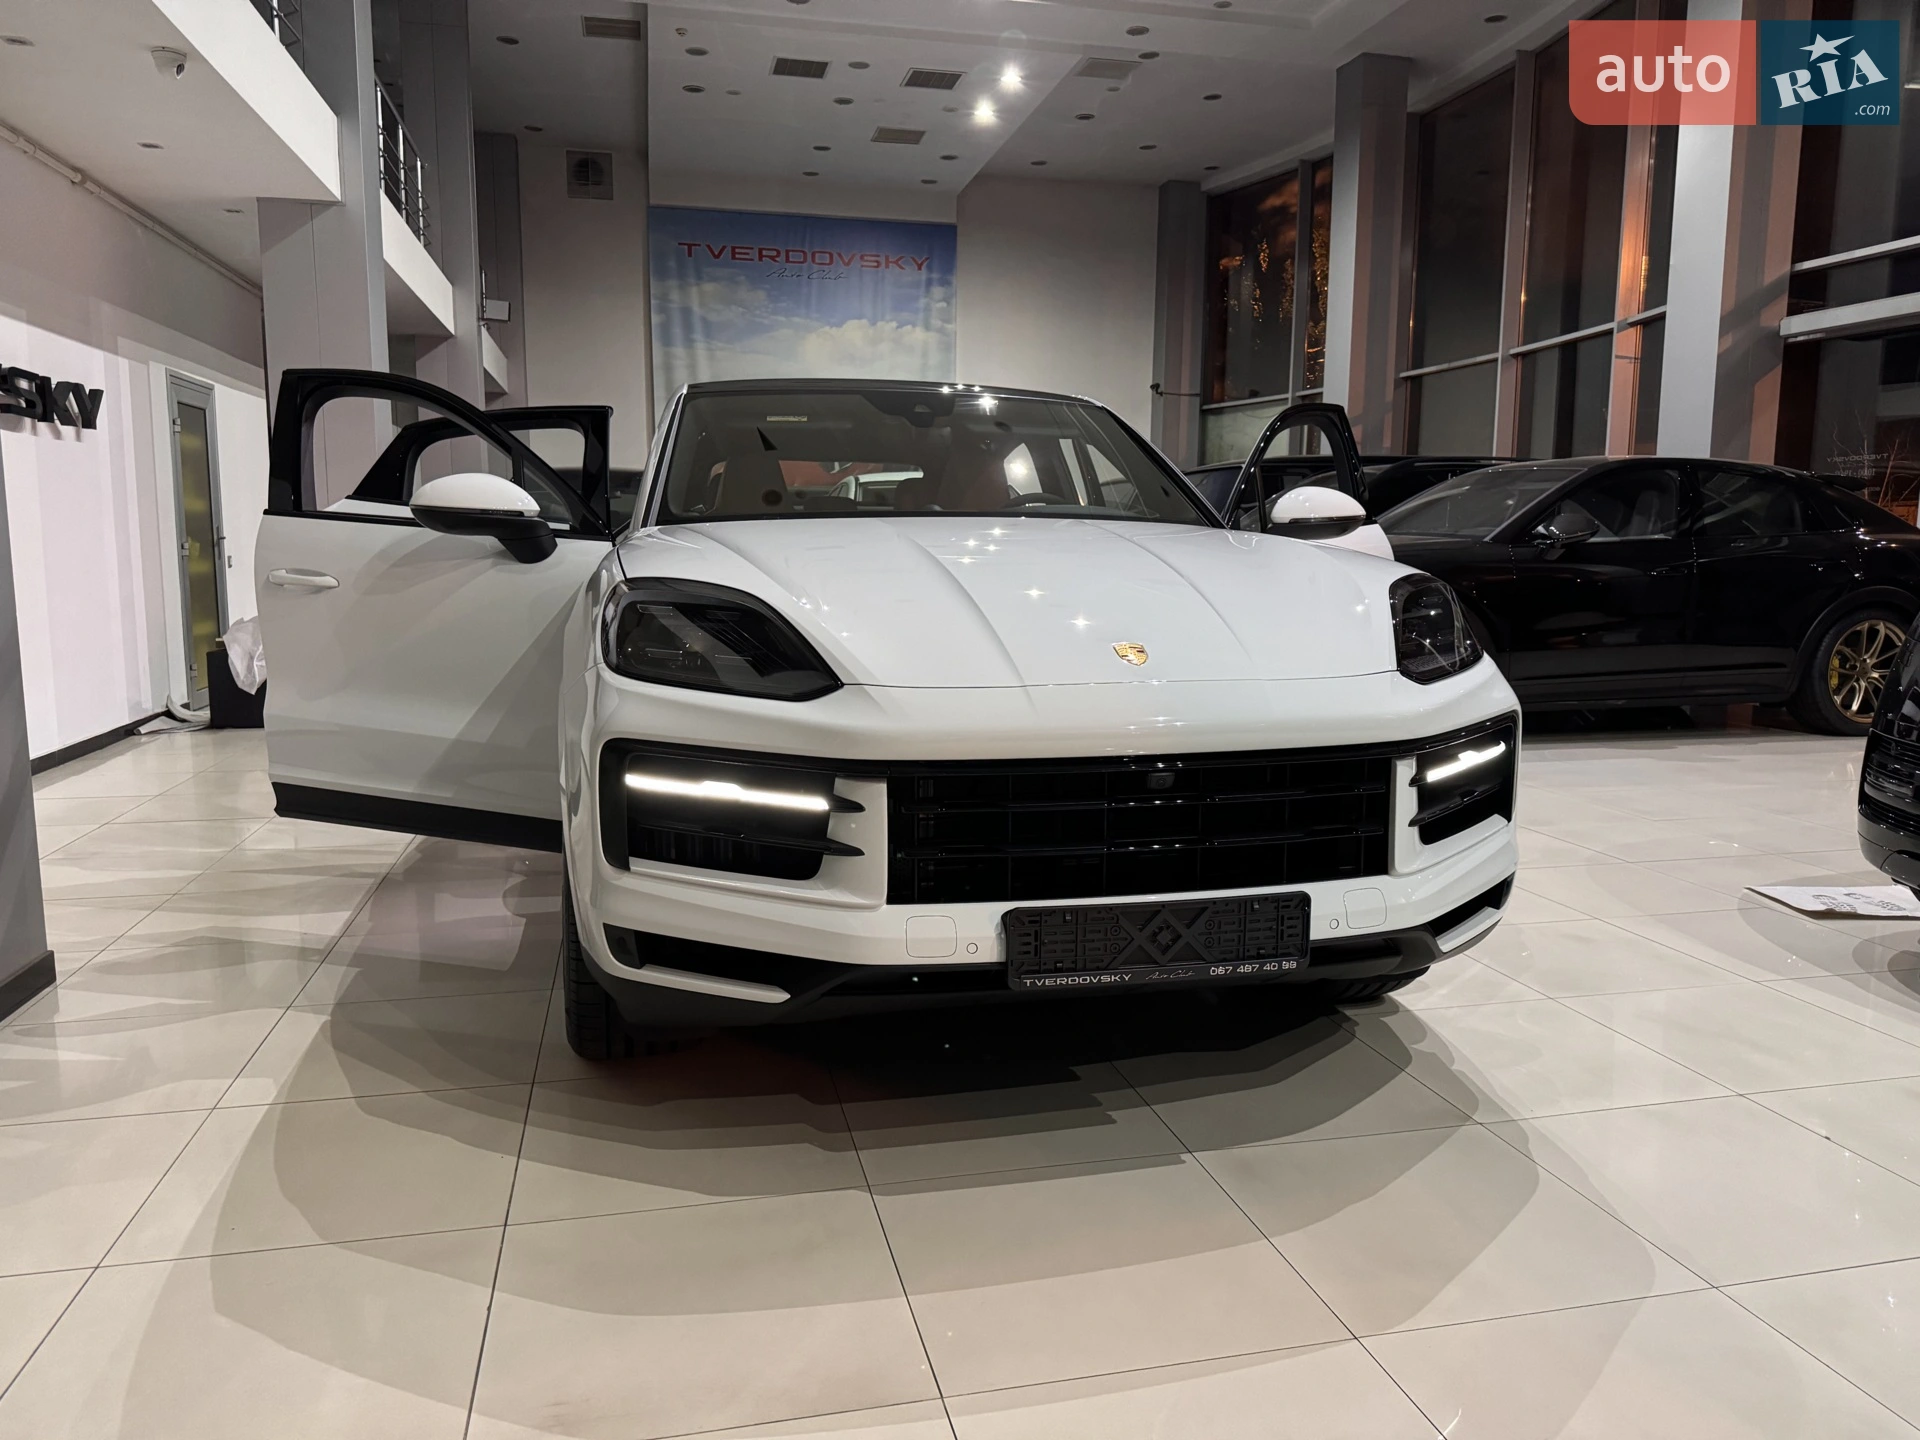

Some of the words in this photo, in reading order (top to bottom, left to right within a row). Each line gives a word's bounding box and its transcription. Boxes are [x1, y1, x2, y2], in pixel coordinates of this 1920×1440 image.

[677, 242, 930, 271] TVERDOVSKY
[0, 364, 104, 430] SKY
[1023, 973, 1132, 987] TVERDOVSKY
[1209, 966, 1233, 976] 067
[1236, 964, 1260, 973] 487
[1263, 962, 1278, 971] 40
